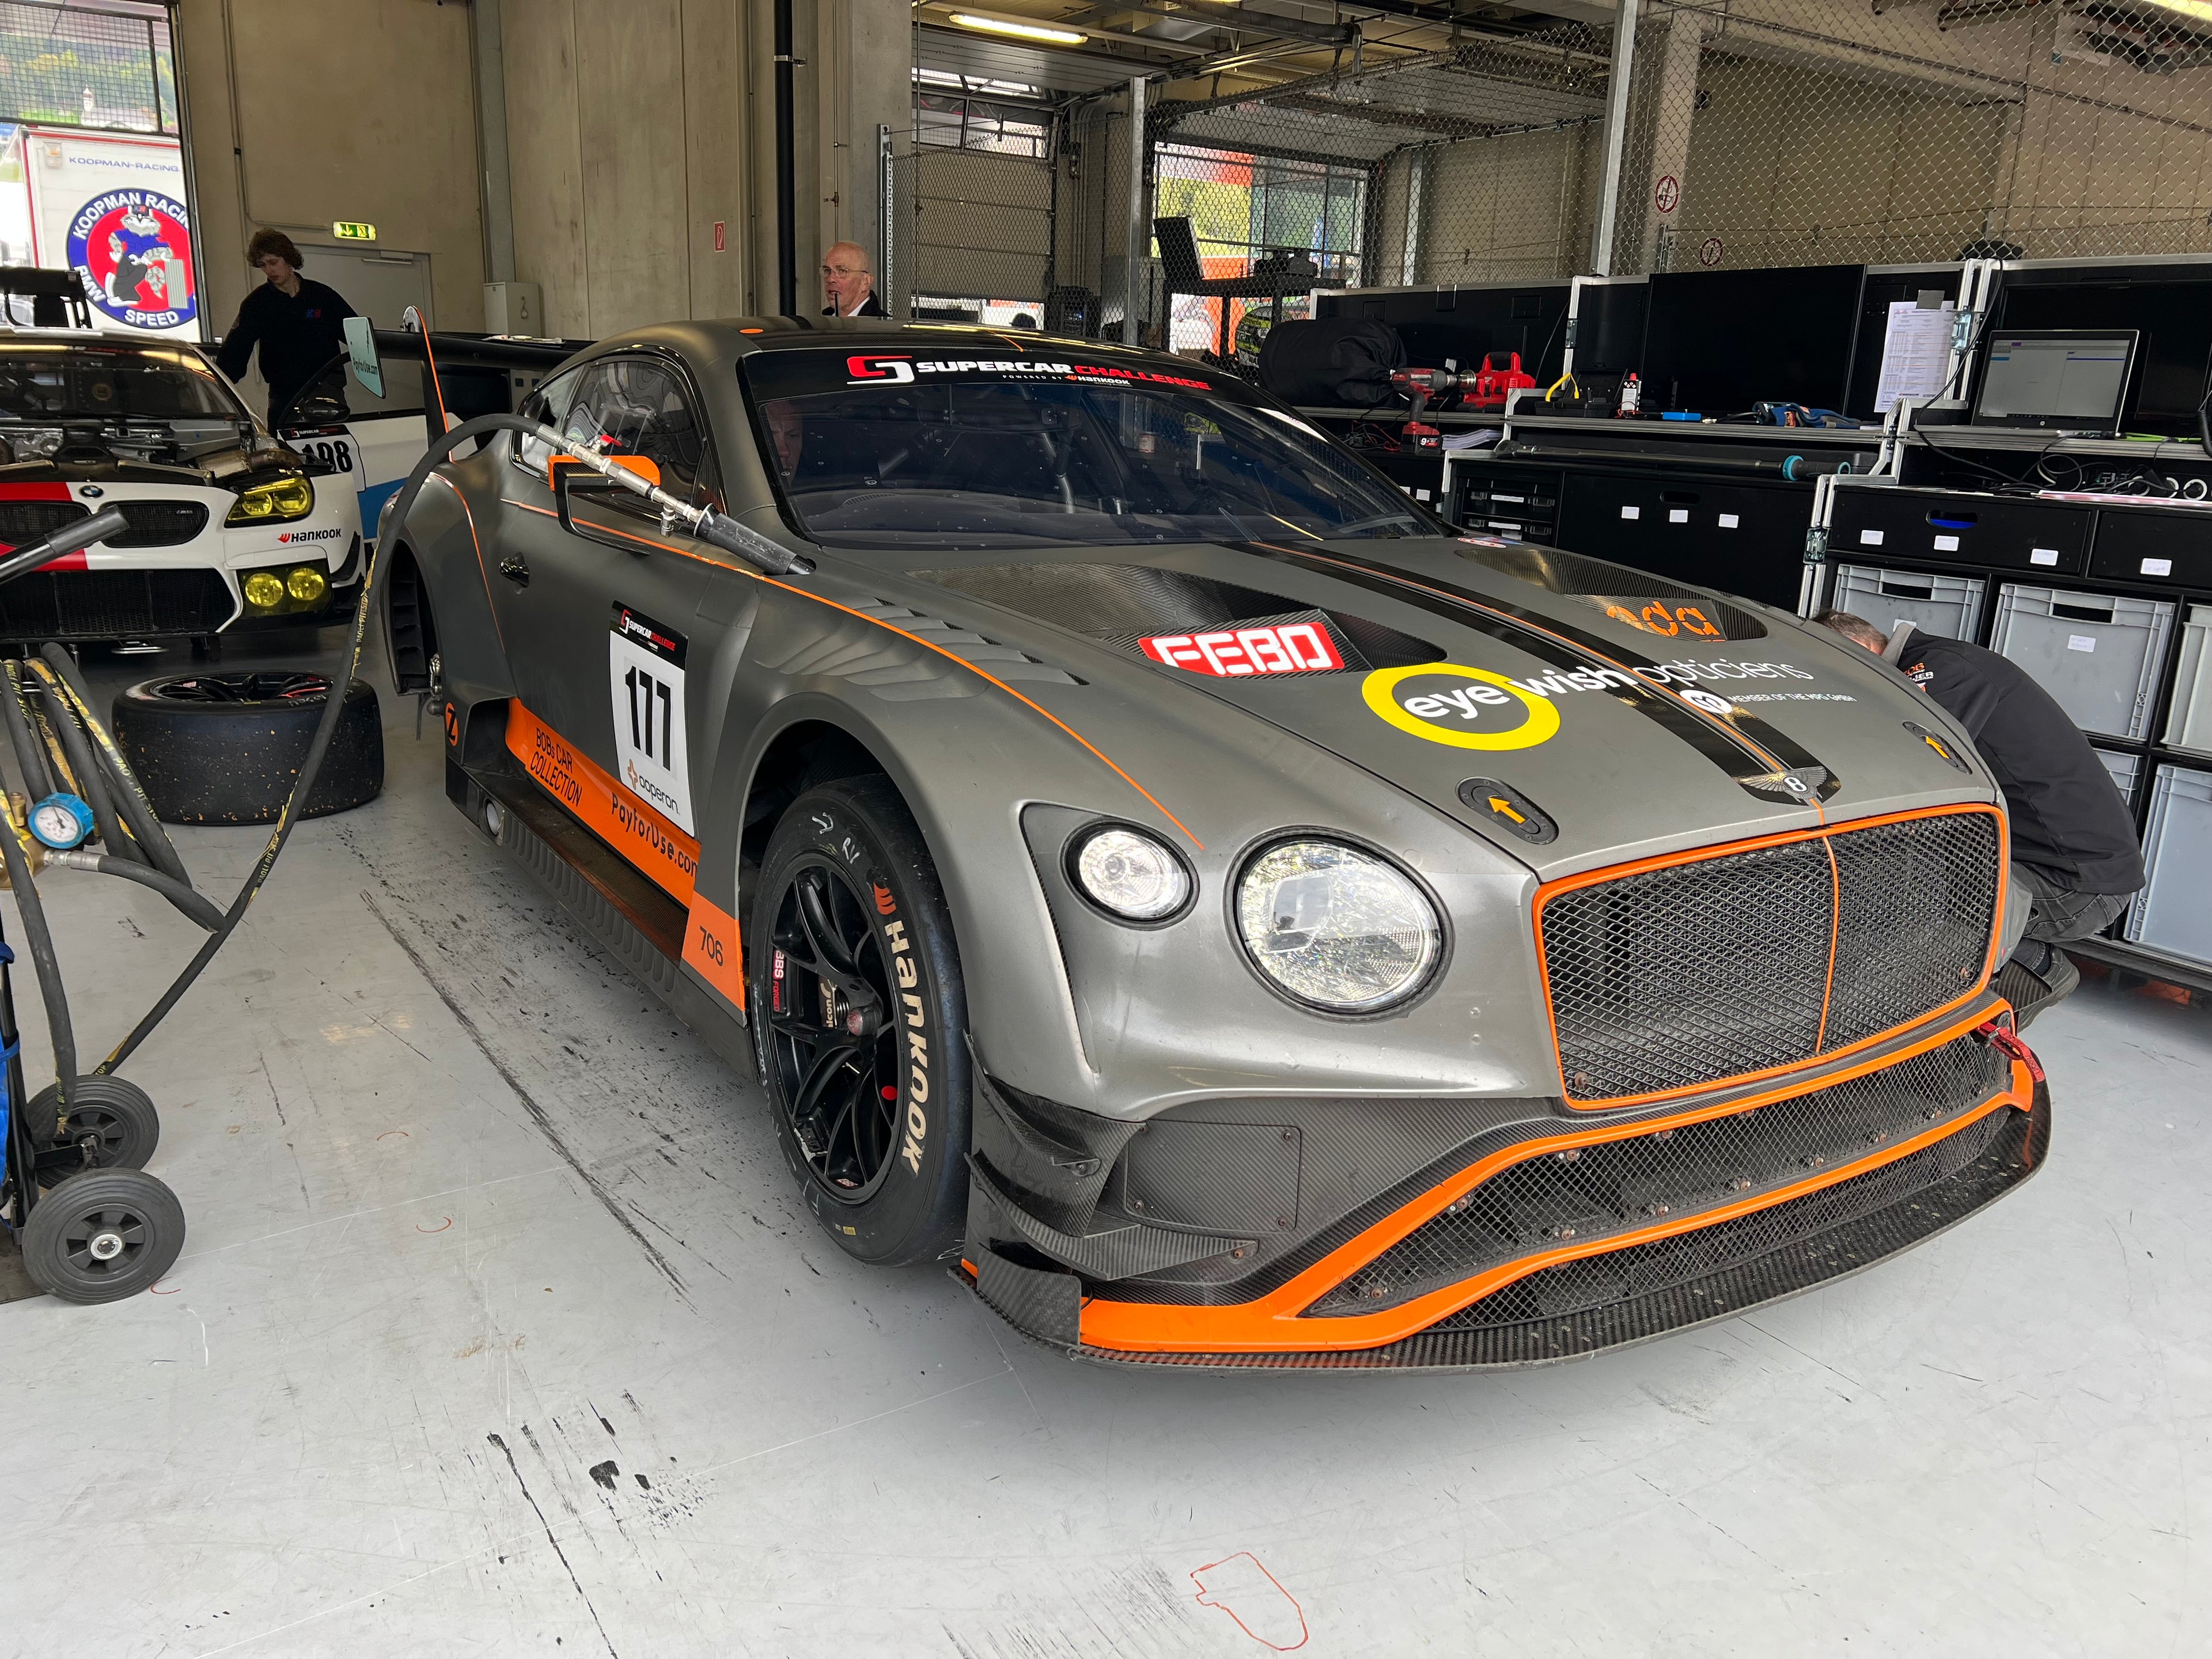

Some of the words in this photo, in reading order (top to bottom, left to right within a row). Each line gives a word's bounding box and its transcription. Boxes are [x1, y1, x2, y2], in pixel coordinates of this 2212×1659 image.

[73, 192, 142, 239] KOOPMAN
[124, 310, 179, 326] SPEED
[916, 361, 1075, 374] SUPERCAR
[1074, 365, 1213, 391] CHALLENGE
[1152, 624, 1333, 676] FEBO
[1404, 685, 1510, 719] eye
[1508, 666, 1639, 697] wish
[1632, 658, 1815, 687] opticiens
[1728, 694, 1775, 703] MEMBER
[625, 665, 671, 771] 177
[530, 751, 582, 807] COLLECTION
[556, 743, 573, 774] CAR
[699, 925, 724, 967] 706
[775, 950, 784, 979] BBS
